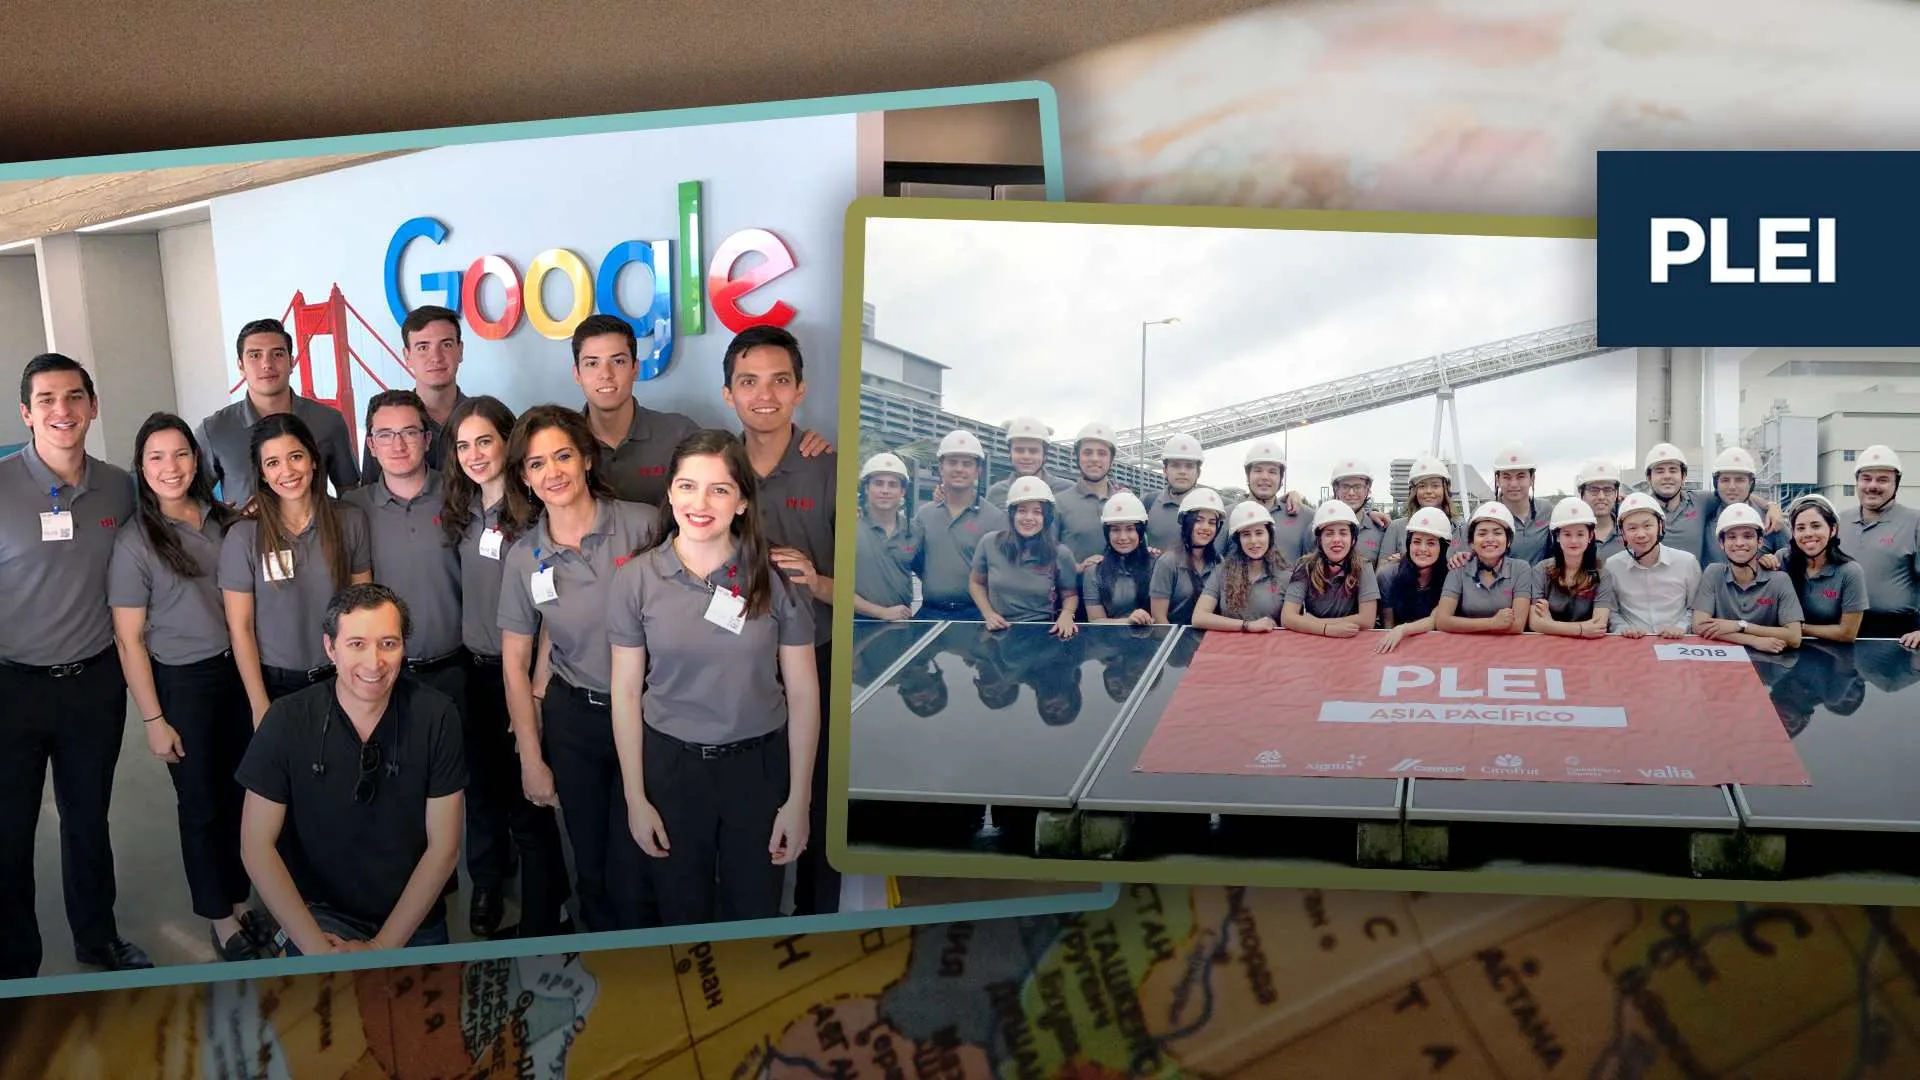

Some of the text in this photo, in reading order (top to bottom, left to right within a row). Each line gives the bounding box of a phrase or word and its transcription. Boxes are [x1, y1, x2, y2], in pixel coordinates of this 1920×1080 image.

[384, 180, 798, 381] Google
[1677, 647, 1728, 658] 2018
[1378, 666, 1566, 700] PLEI
[1370, 707, 1575, 723] ASIA PACÍFICO
[1637, 766, 1696, 779] valia
